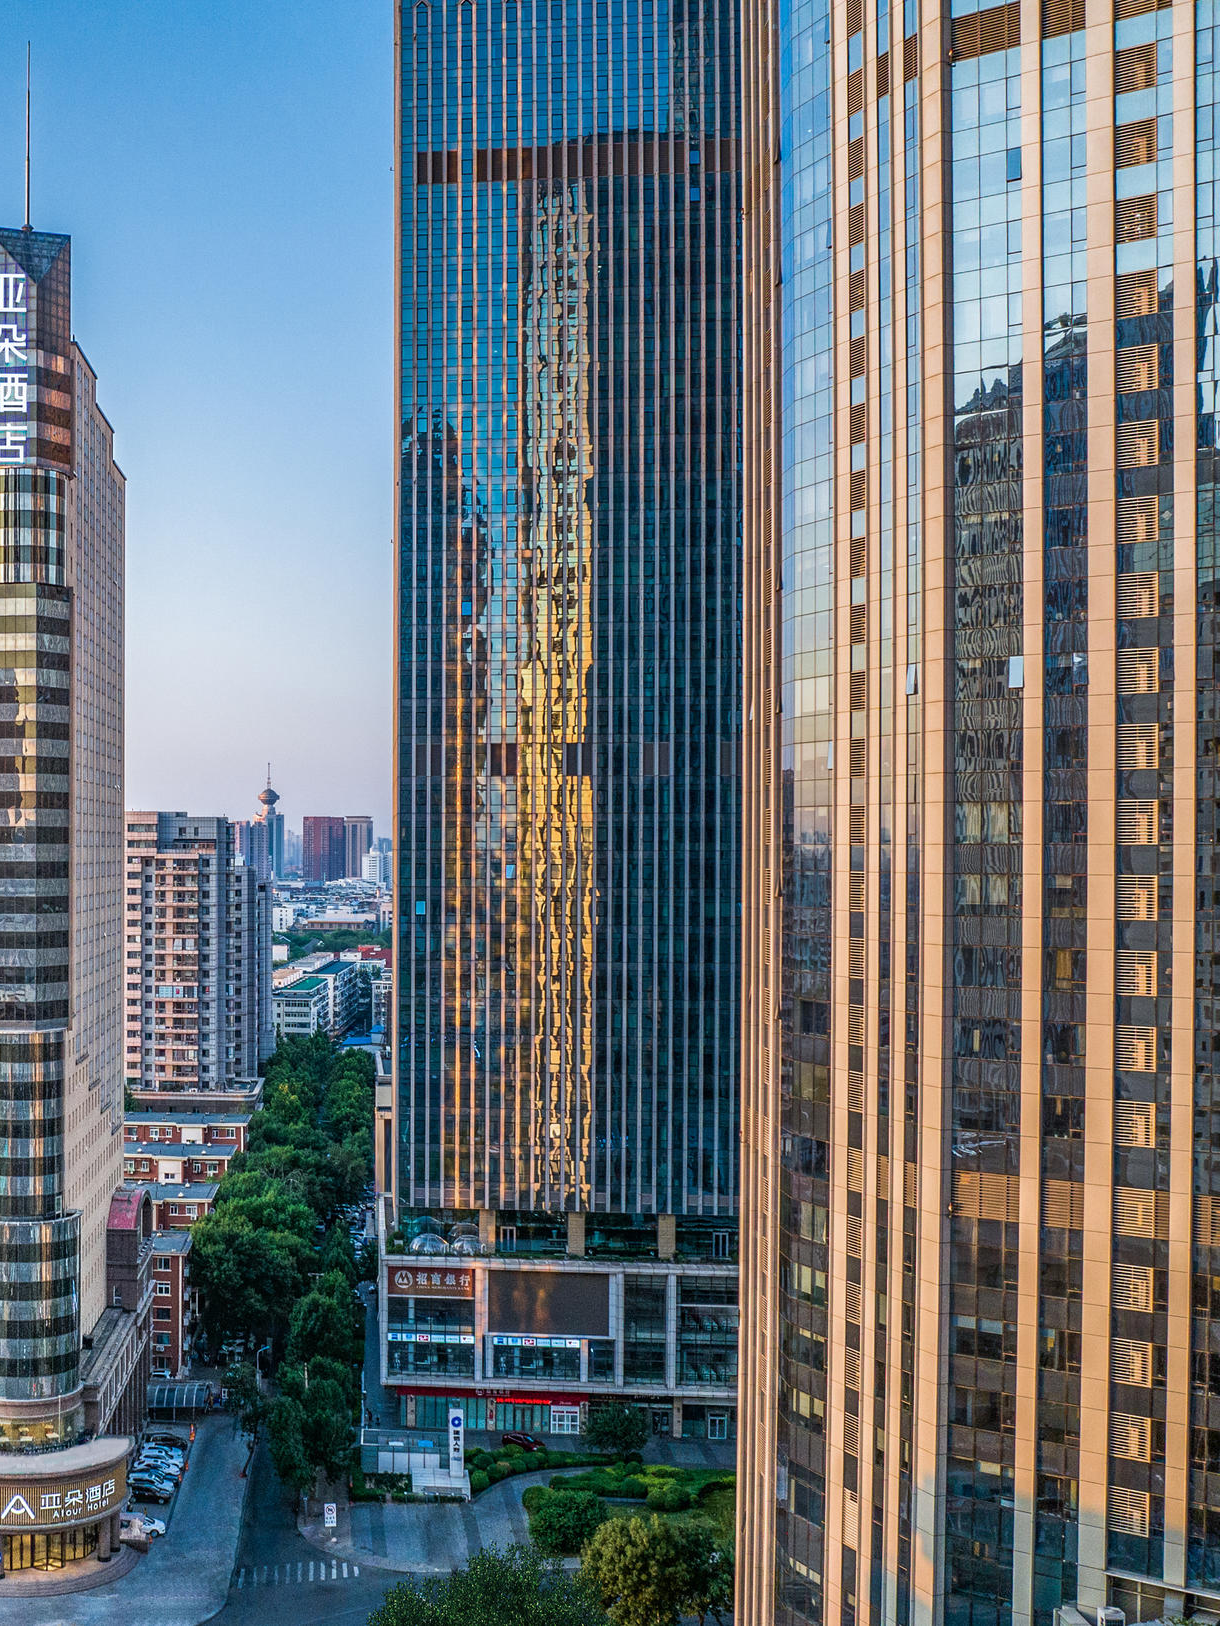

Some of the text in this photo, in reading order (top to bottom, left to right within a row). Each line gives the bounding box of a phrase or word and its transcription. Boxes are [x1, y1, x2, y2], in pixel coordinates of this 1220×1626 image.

[416, 1272, 470, 1286] 招商银行
[40, 1479, 115, 1509] 亚朵酒店
[52, 1498, 109, 1518] Atour Hotel
